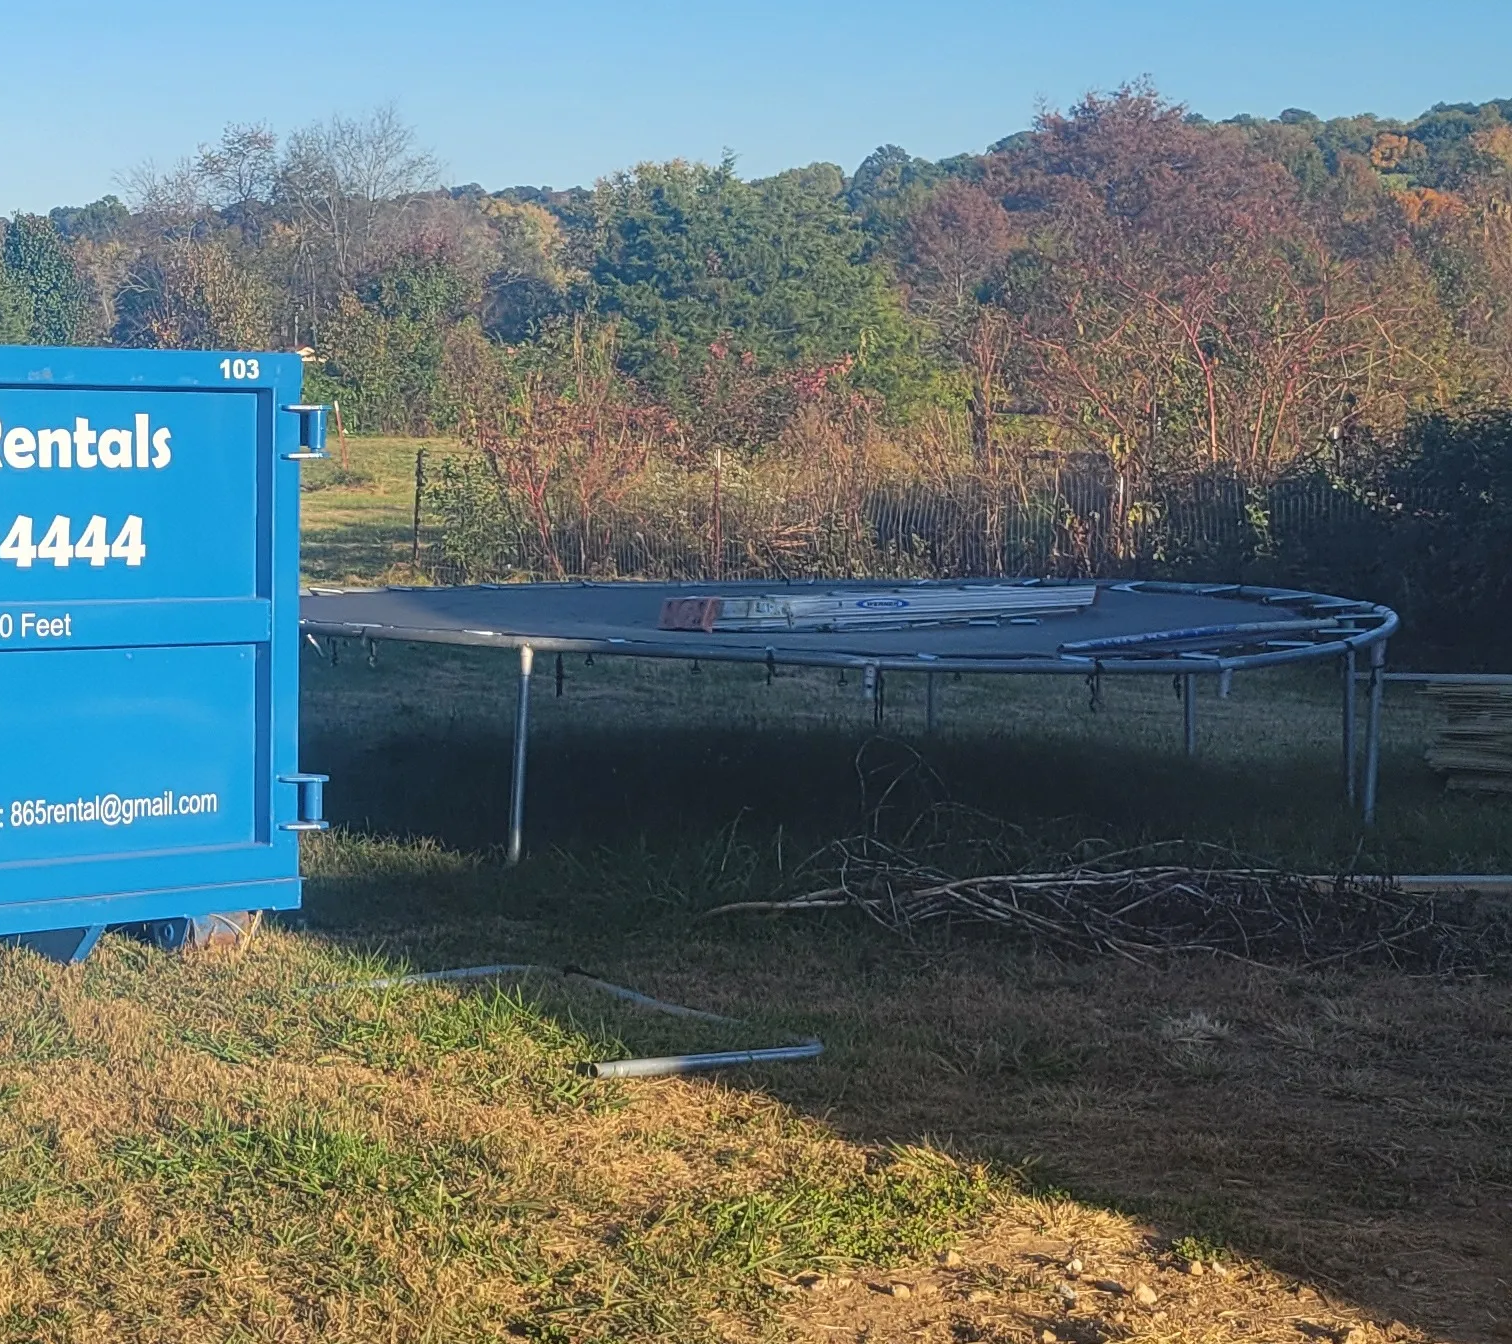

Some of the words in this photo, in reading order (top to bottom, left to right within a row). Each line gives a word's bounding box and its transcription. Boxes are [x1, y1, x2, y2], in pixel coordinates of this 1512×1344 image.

[219, 358, 260, 380] 103
[21, 612, 73, 638] Feet
[10, 790, 218, 827] 865rental@gmail.com
